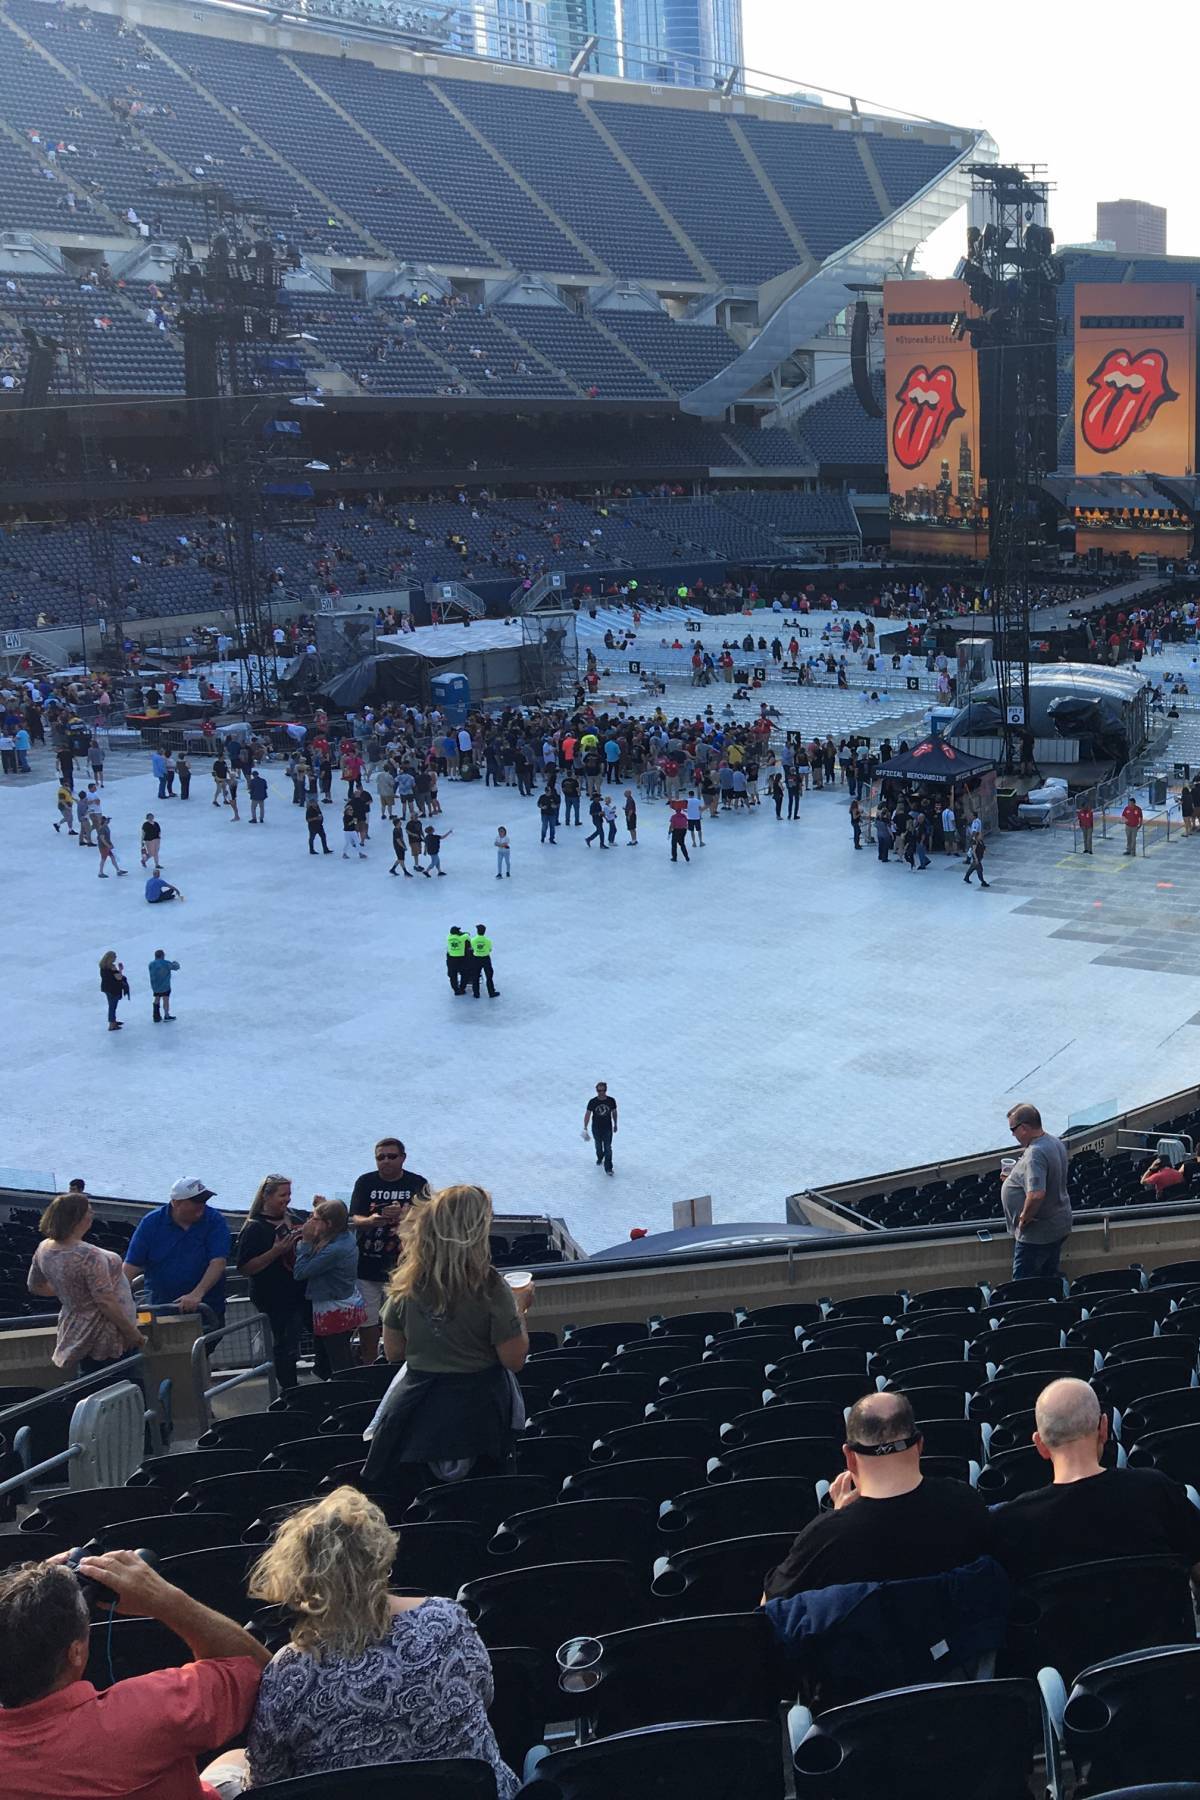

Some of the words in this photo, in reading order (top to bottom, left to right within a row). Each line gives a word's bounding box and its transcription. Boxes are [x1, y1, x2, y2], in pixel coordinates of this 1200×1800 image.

[789, 733, 798, 745] K
[875, 769, 904, 778] OFFICIAL
[370, 1190, 411, 1200] STONES
